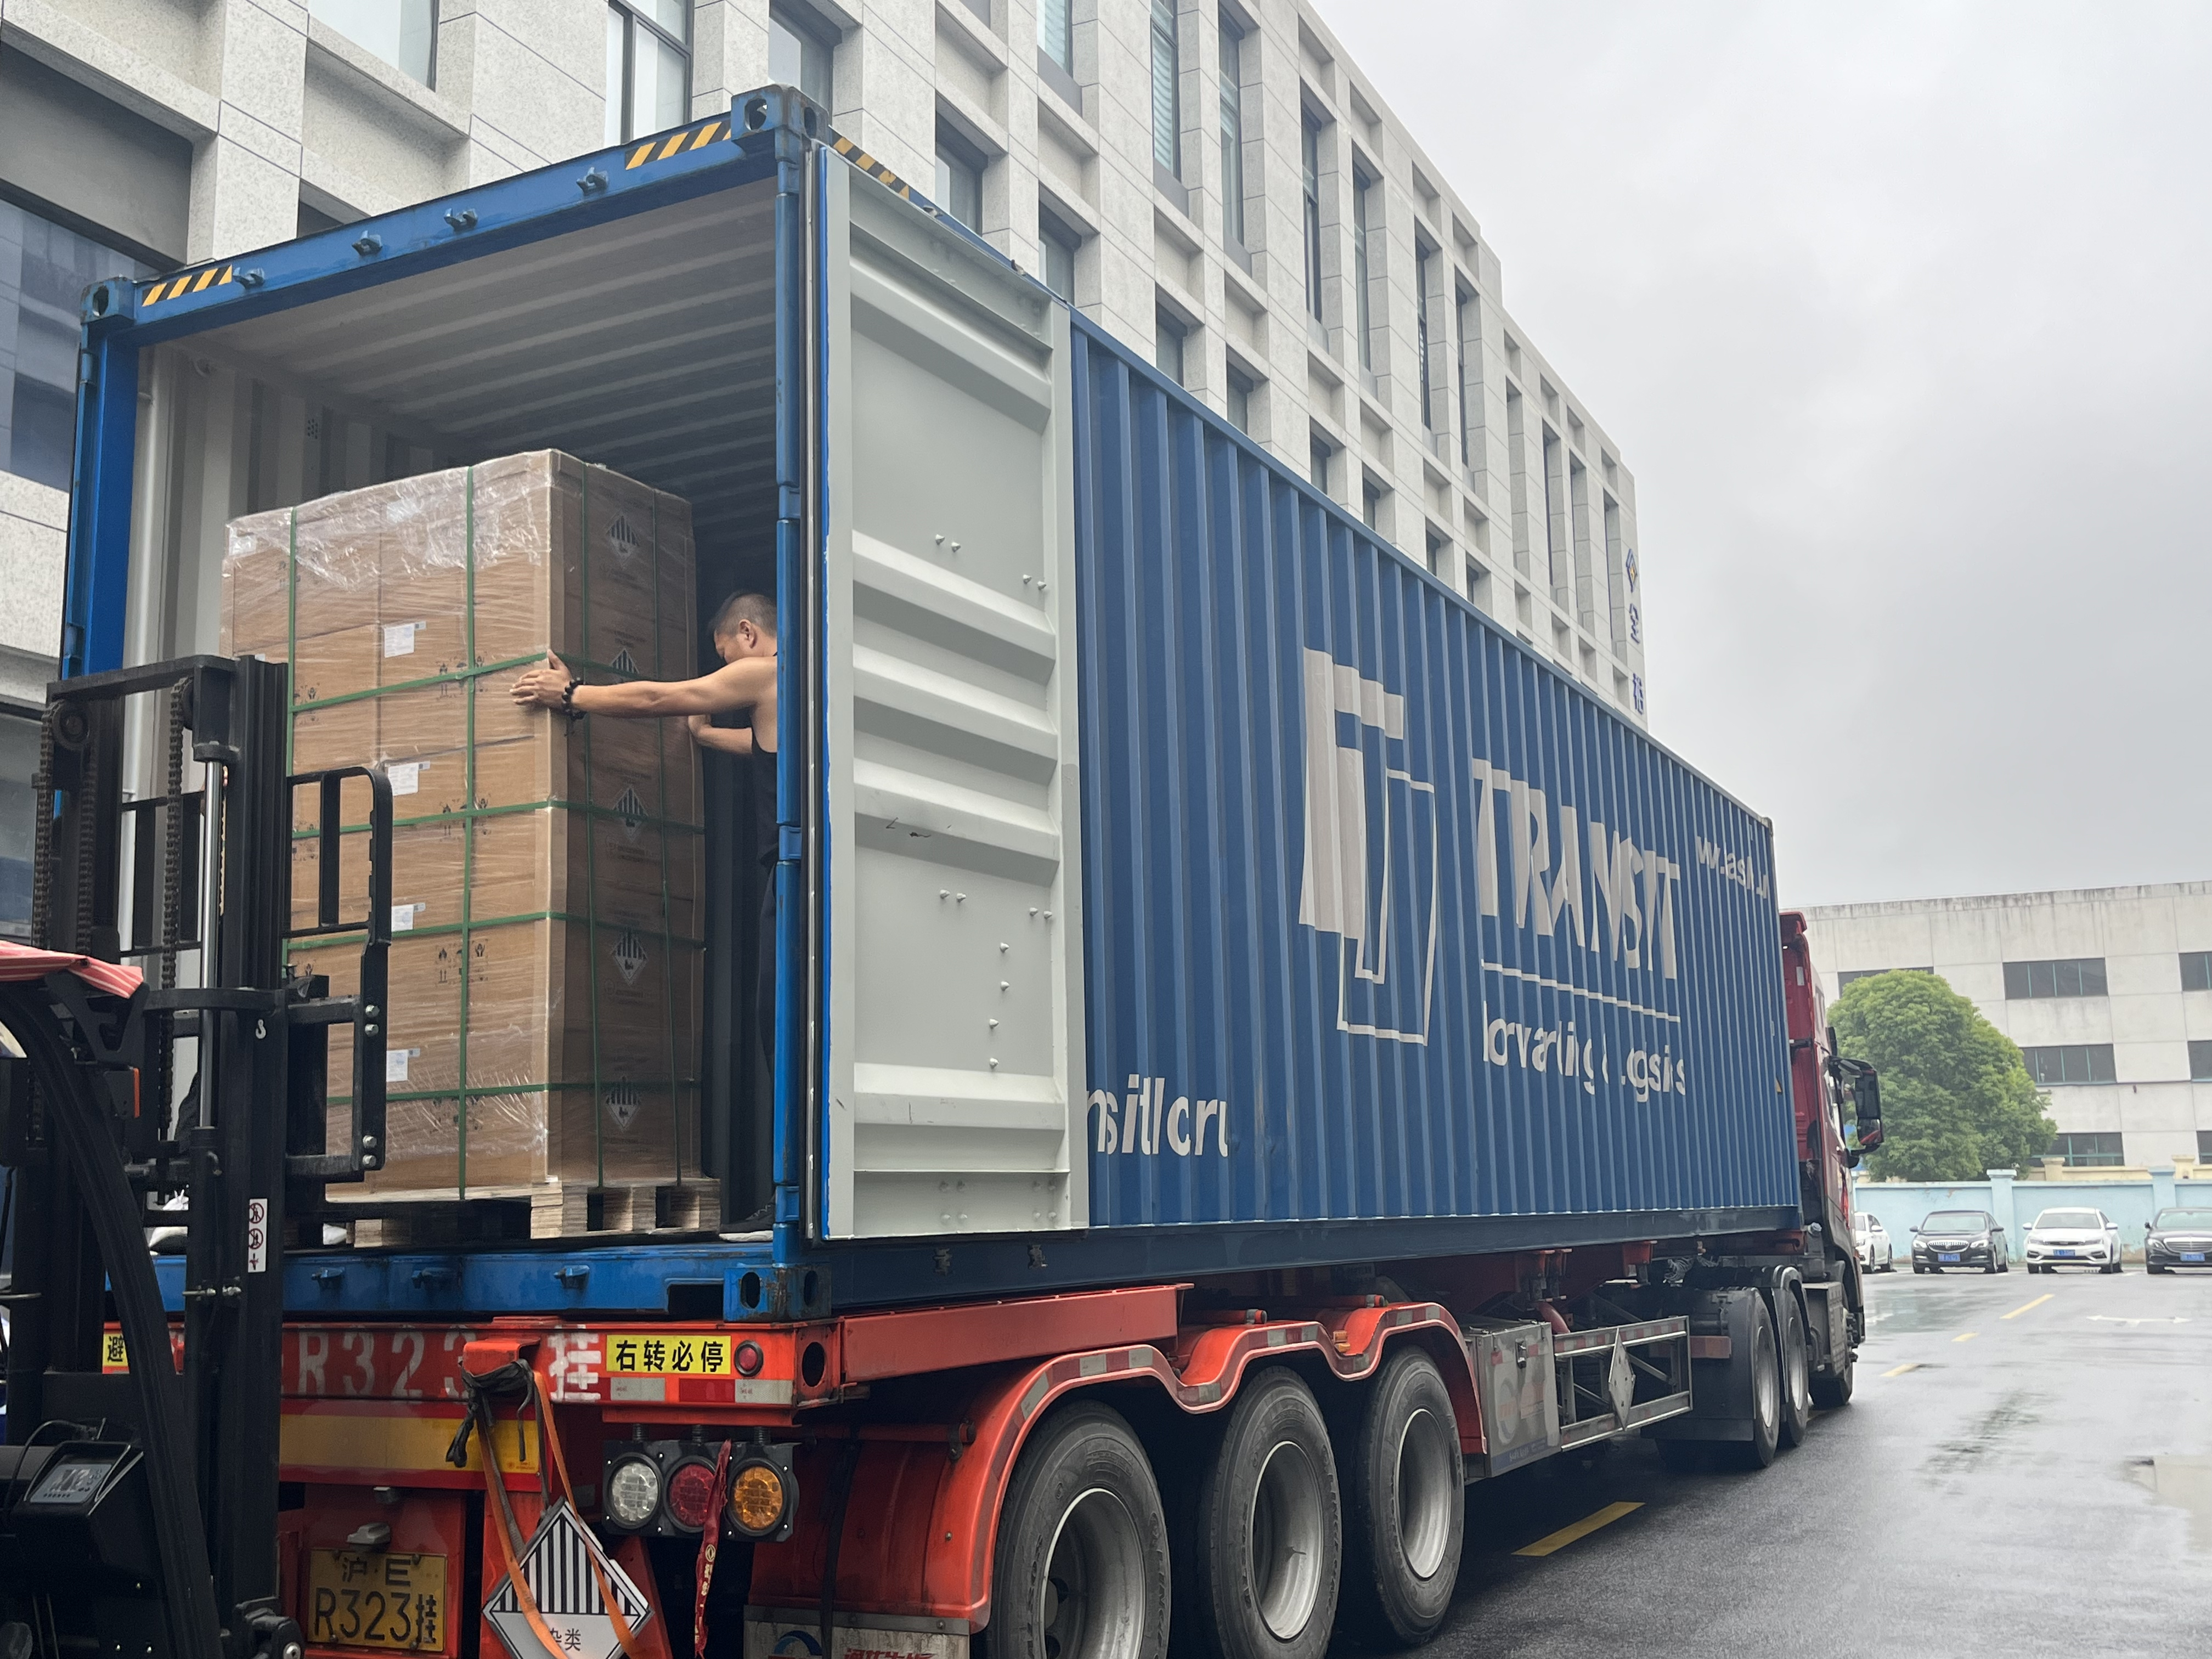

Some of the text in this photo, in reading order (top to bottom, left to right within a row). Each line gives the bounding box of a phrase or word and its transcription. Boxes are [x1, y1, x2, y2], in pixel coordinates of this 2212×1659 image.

[616, 1340, 723, 1373] 右转必停
[315, 1587, 438, 1645] R323挂
